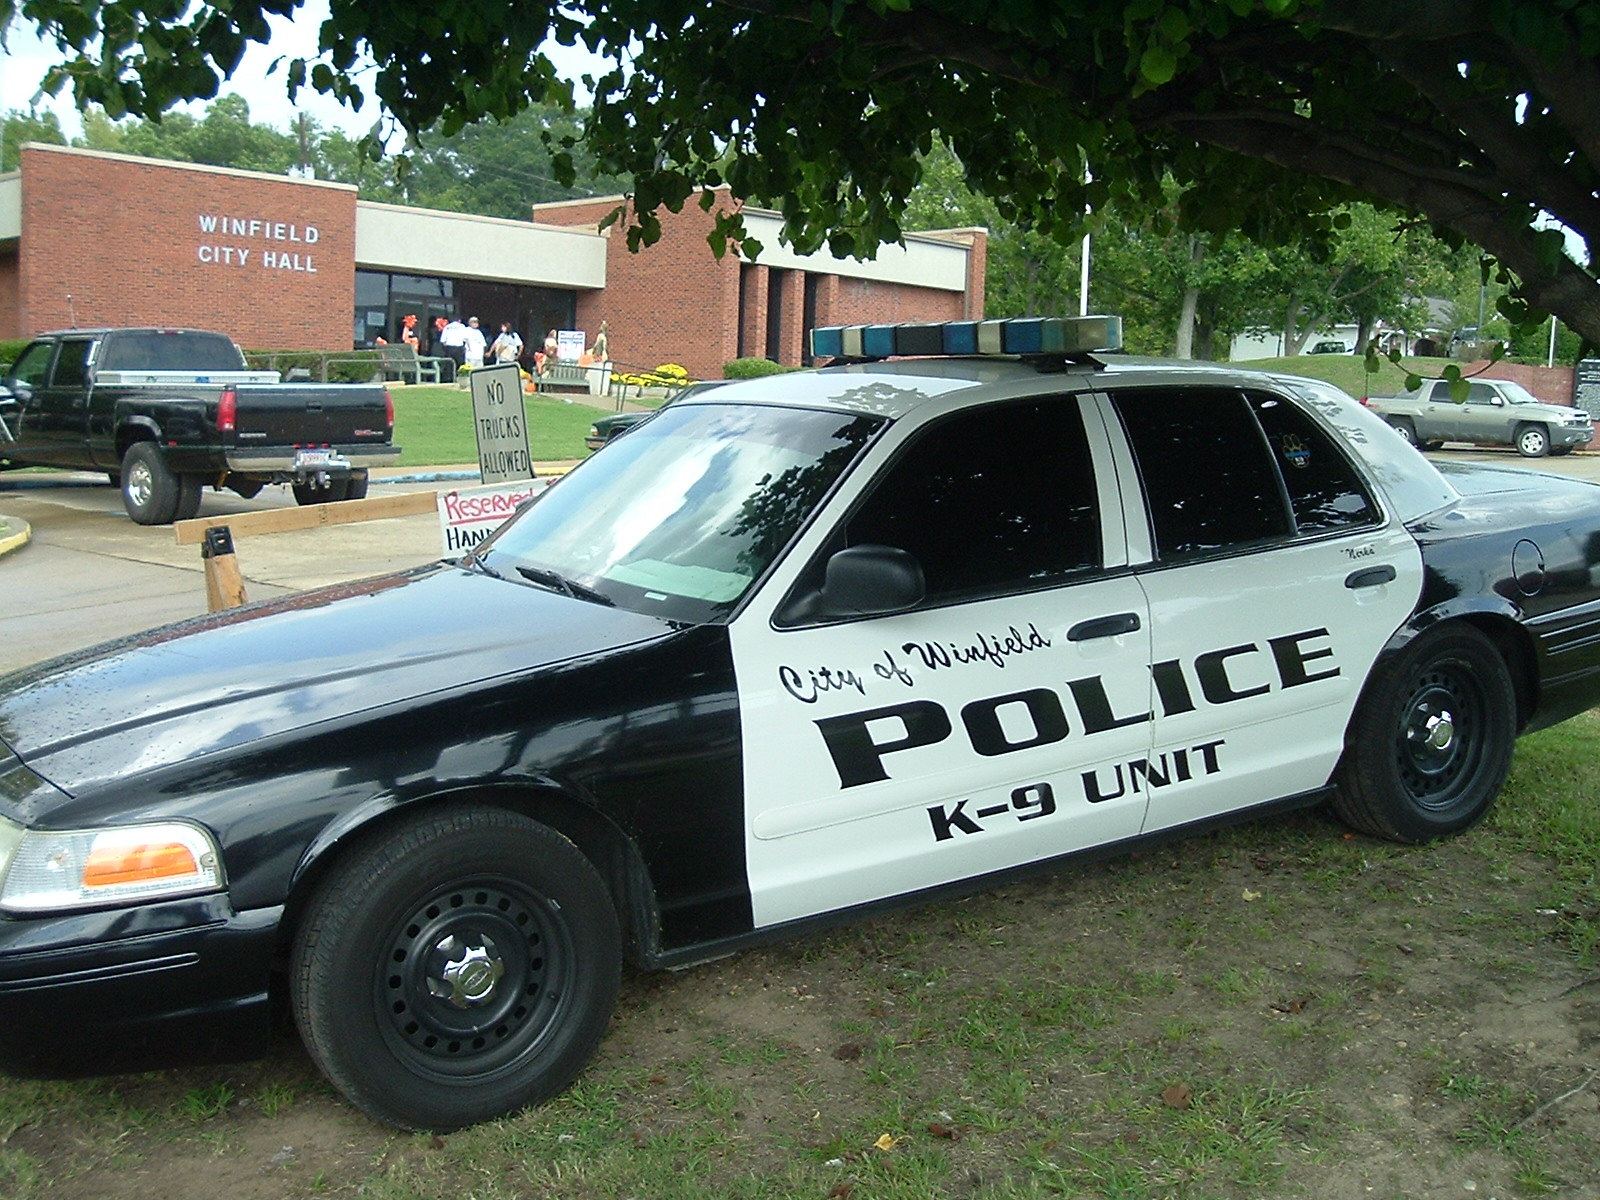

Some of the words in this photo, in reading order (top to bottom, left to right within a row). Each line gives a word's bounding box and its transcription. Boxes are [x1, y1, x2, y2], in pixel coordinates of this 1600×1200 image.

[199, 215, 319, 243] WINFIELD
[198, 246, 249, 266] CITY
[264, 251, 317, 272] HALL
[487, 382, 504, 406] NO
[480, 415, 521, 440] TRUCKS
[484, 450, 528, 474] ALLOWED
[779, 665, 866, 703] City
[873, 650, 913, 687] of
[901, 623, 1051, 668] Winfield
[812, 627, 1341, 789] POLICE
[927, 782, 1056, 842] K-9
[1081, 739, 1226, 804] UNIT
